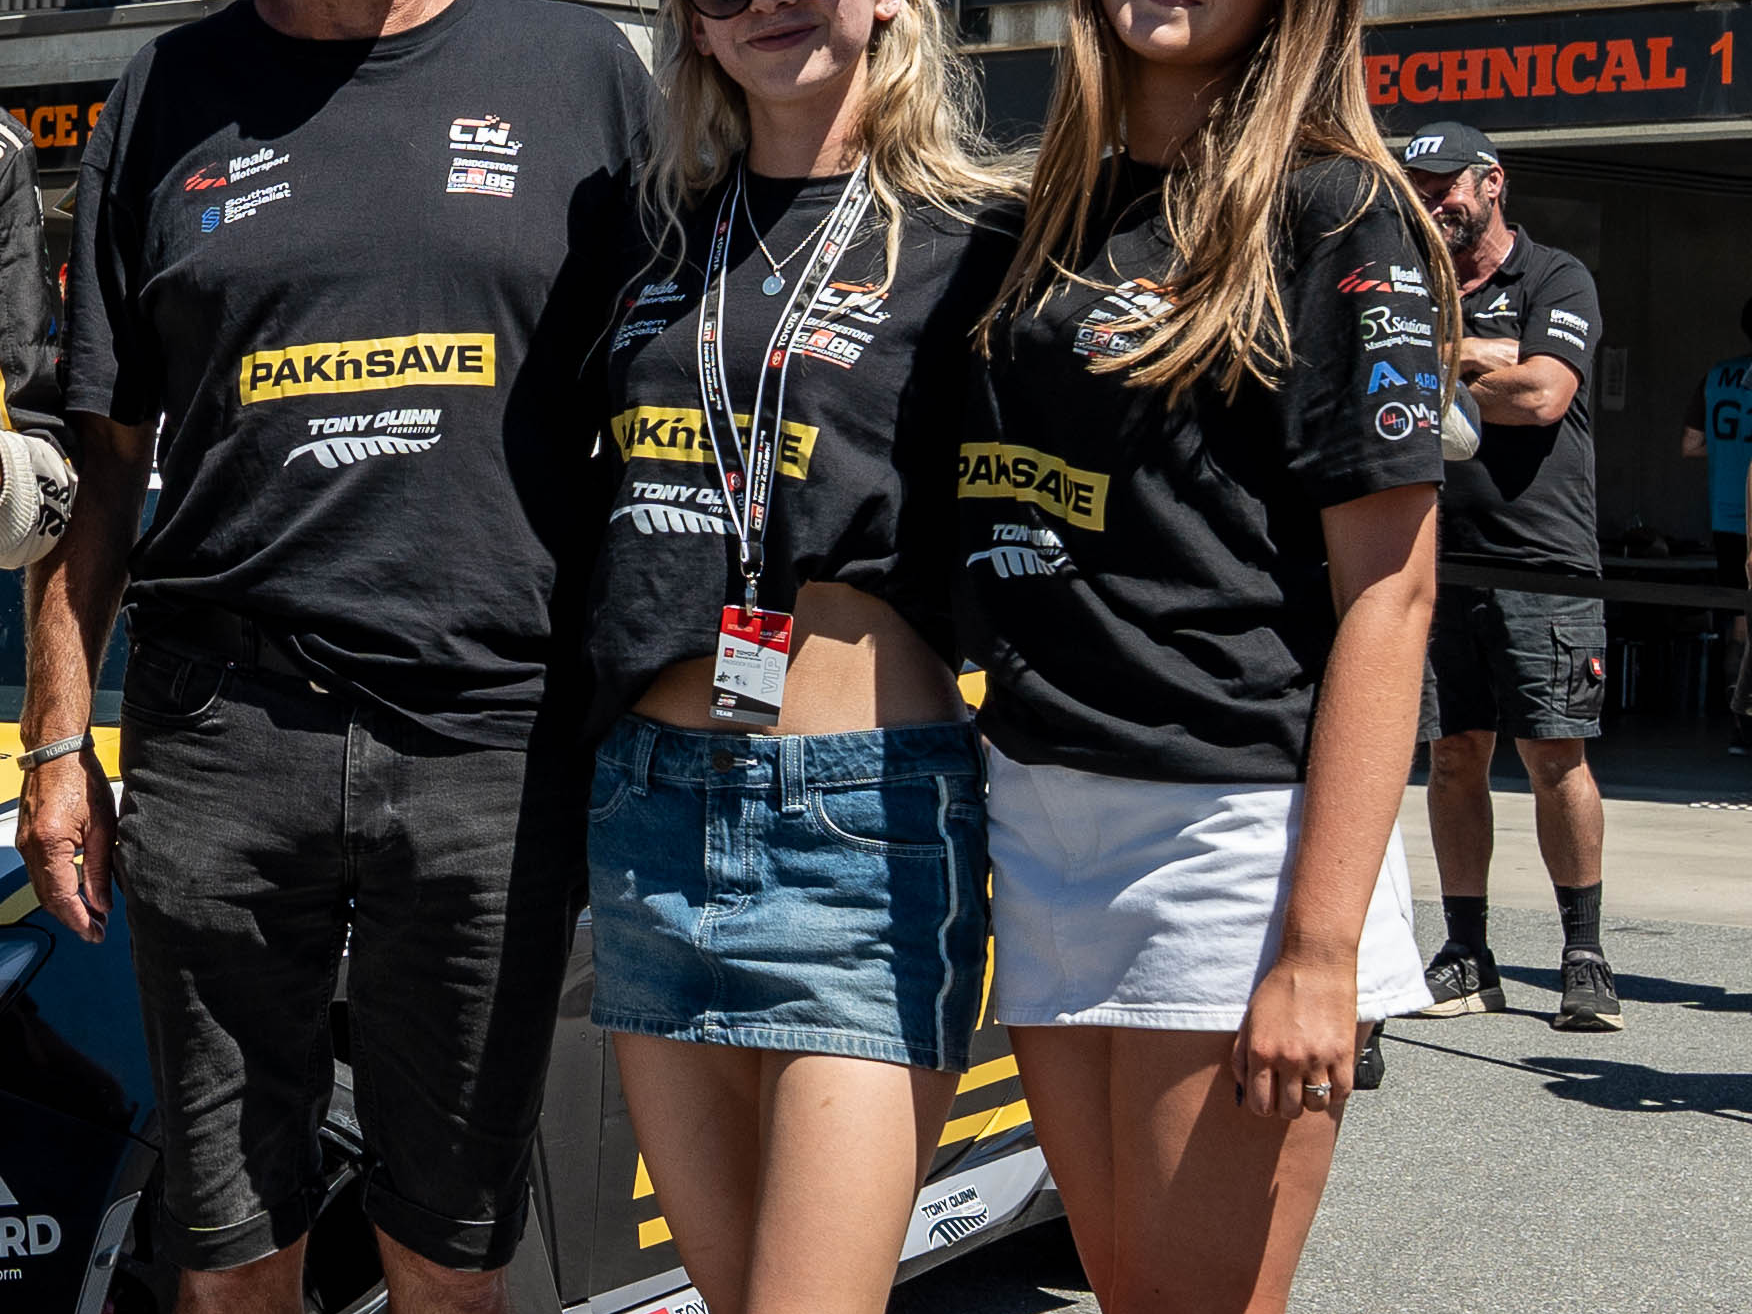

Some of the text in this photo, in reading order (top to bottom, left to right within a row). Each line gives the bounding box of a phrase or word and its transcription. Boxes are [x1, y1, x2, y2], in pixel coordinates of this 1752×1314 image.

[1365, 32, 1734, 106] ECHNICAL 1
[10, 105, 78, 149] ACE
[229, 148, 275, 174] Neale
[230, 154, 290, 183] Motorsport
[225, 182, 290, 206] Southern
[225, 189, 292, 216] Specialist
[224, 208, 256, 224] Cars
[777, 312, 801, 347] TOYOTA
[308, 408, 441, 435] TONY QUINN
[632, 482, 696, 503] TONY
